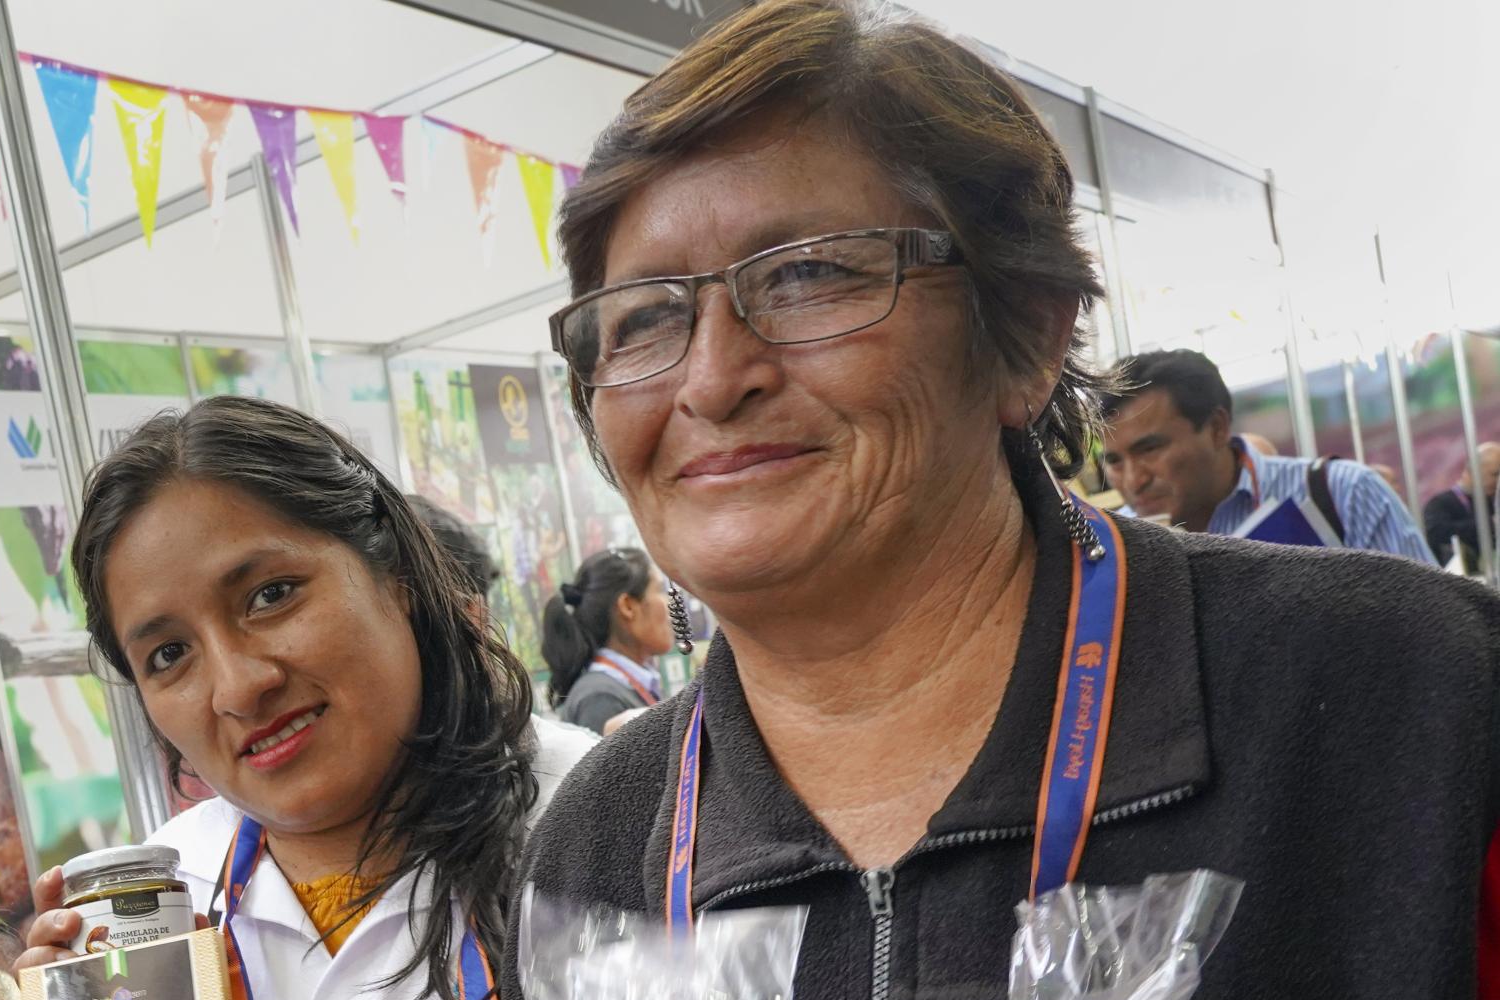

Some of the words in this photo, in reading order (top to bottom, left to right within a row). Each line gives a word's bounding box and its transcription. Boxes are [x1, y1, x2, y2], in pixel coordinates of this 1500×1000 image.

[110, 927, 159, 941] MERMELADA
[160, 926, 170, 934] DE
[122, 936, 148, 946] PULPA
